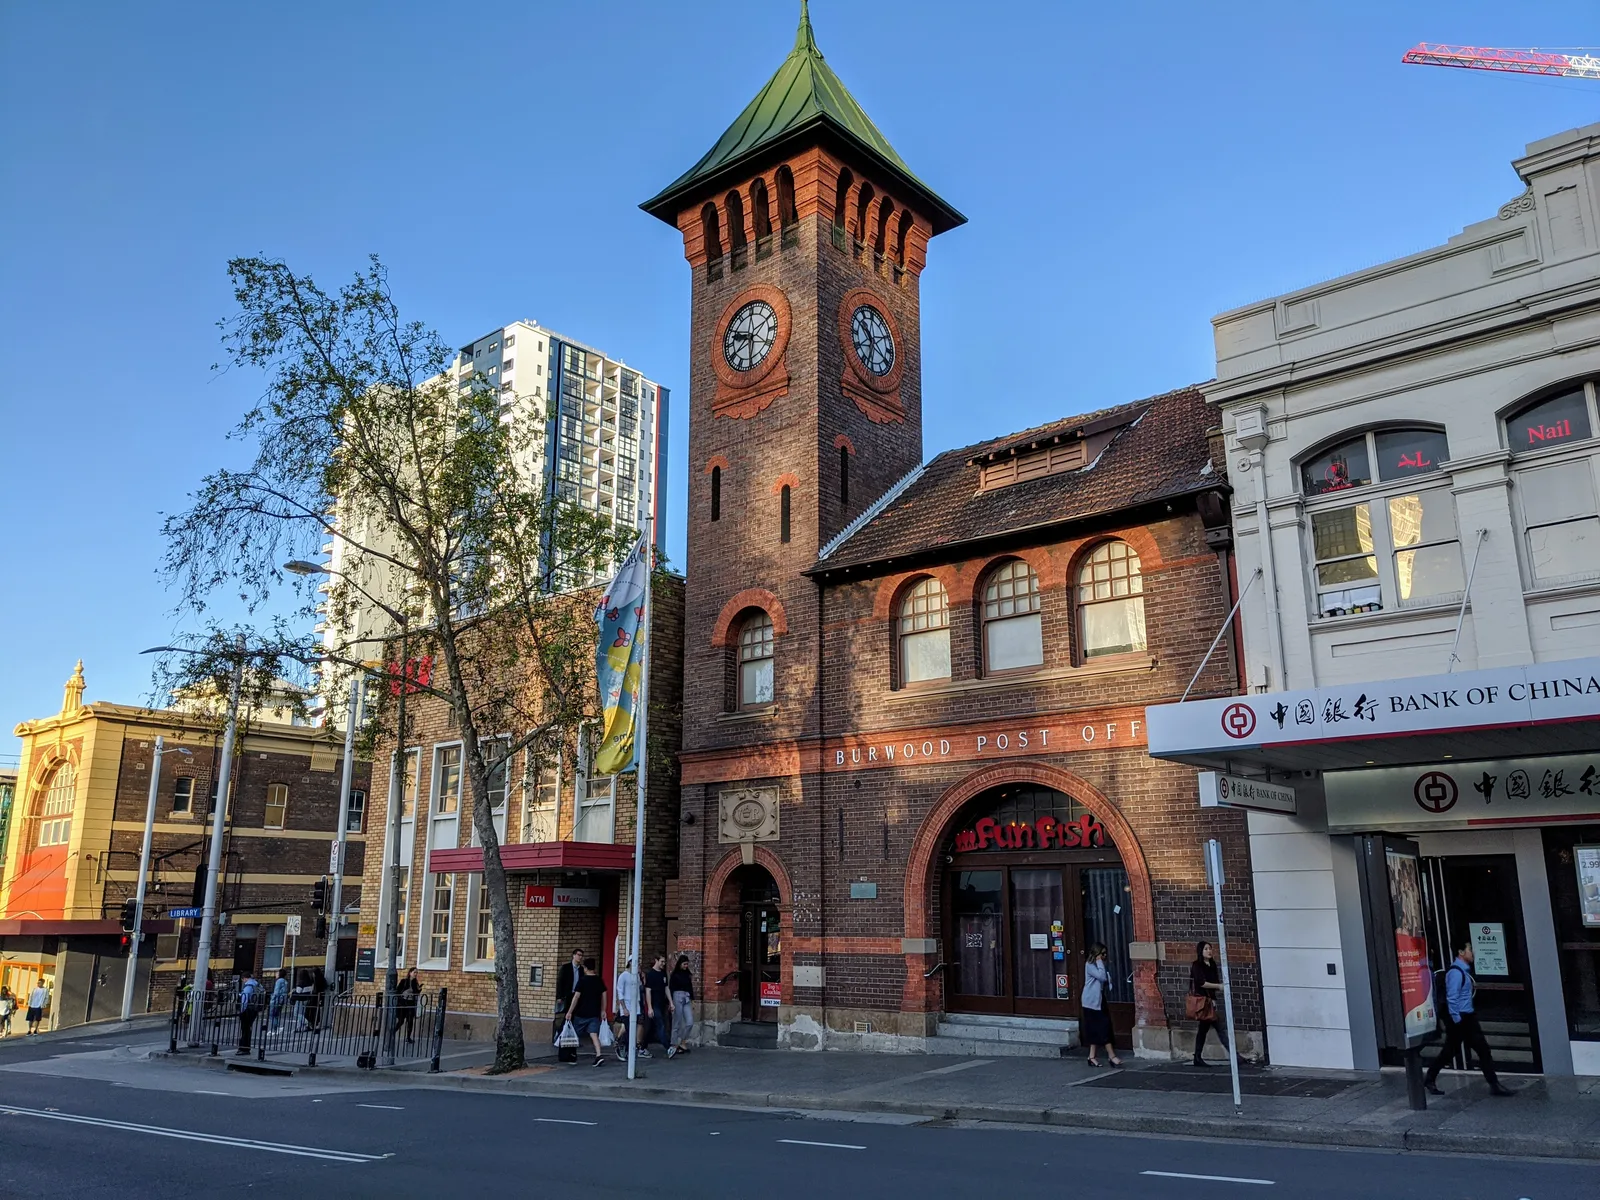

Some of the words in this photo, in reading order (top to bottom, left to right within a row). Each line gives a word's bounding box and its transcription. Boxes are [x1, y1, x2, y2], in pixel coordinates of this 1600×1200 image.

[1527, 420, 1572, 444] Nail
[1389, 690, 1460, 713] BANK
[1466, 686, 1499, 705] OF
[1508, 676, 1600, 701] CHINA
[836, 739, 950, 765] BURWOOD
[977, 729, 1050, 752] POST
[1256, 788, 1271, 799] BANK
[1270, 790, 1277, 800] OF
[1278, 792, 1294, 803] CHINA
[976, 817, 1034, 849] Fun
[1036, 814, 1105, 848] Fish
[529, 895, 546, 903] ATM
[170, 909, 198, 917] LIBRARY
